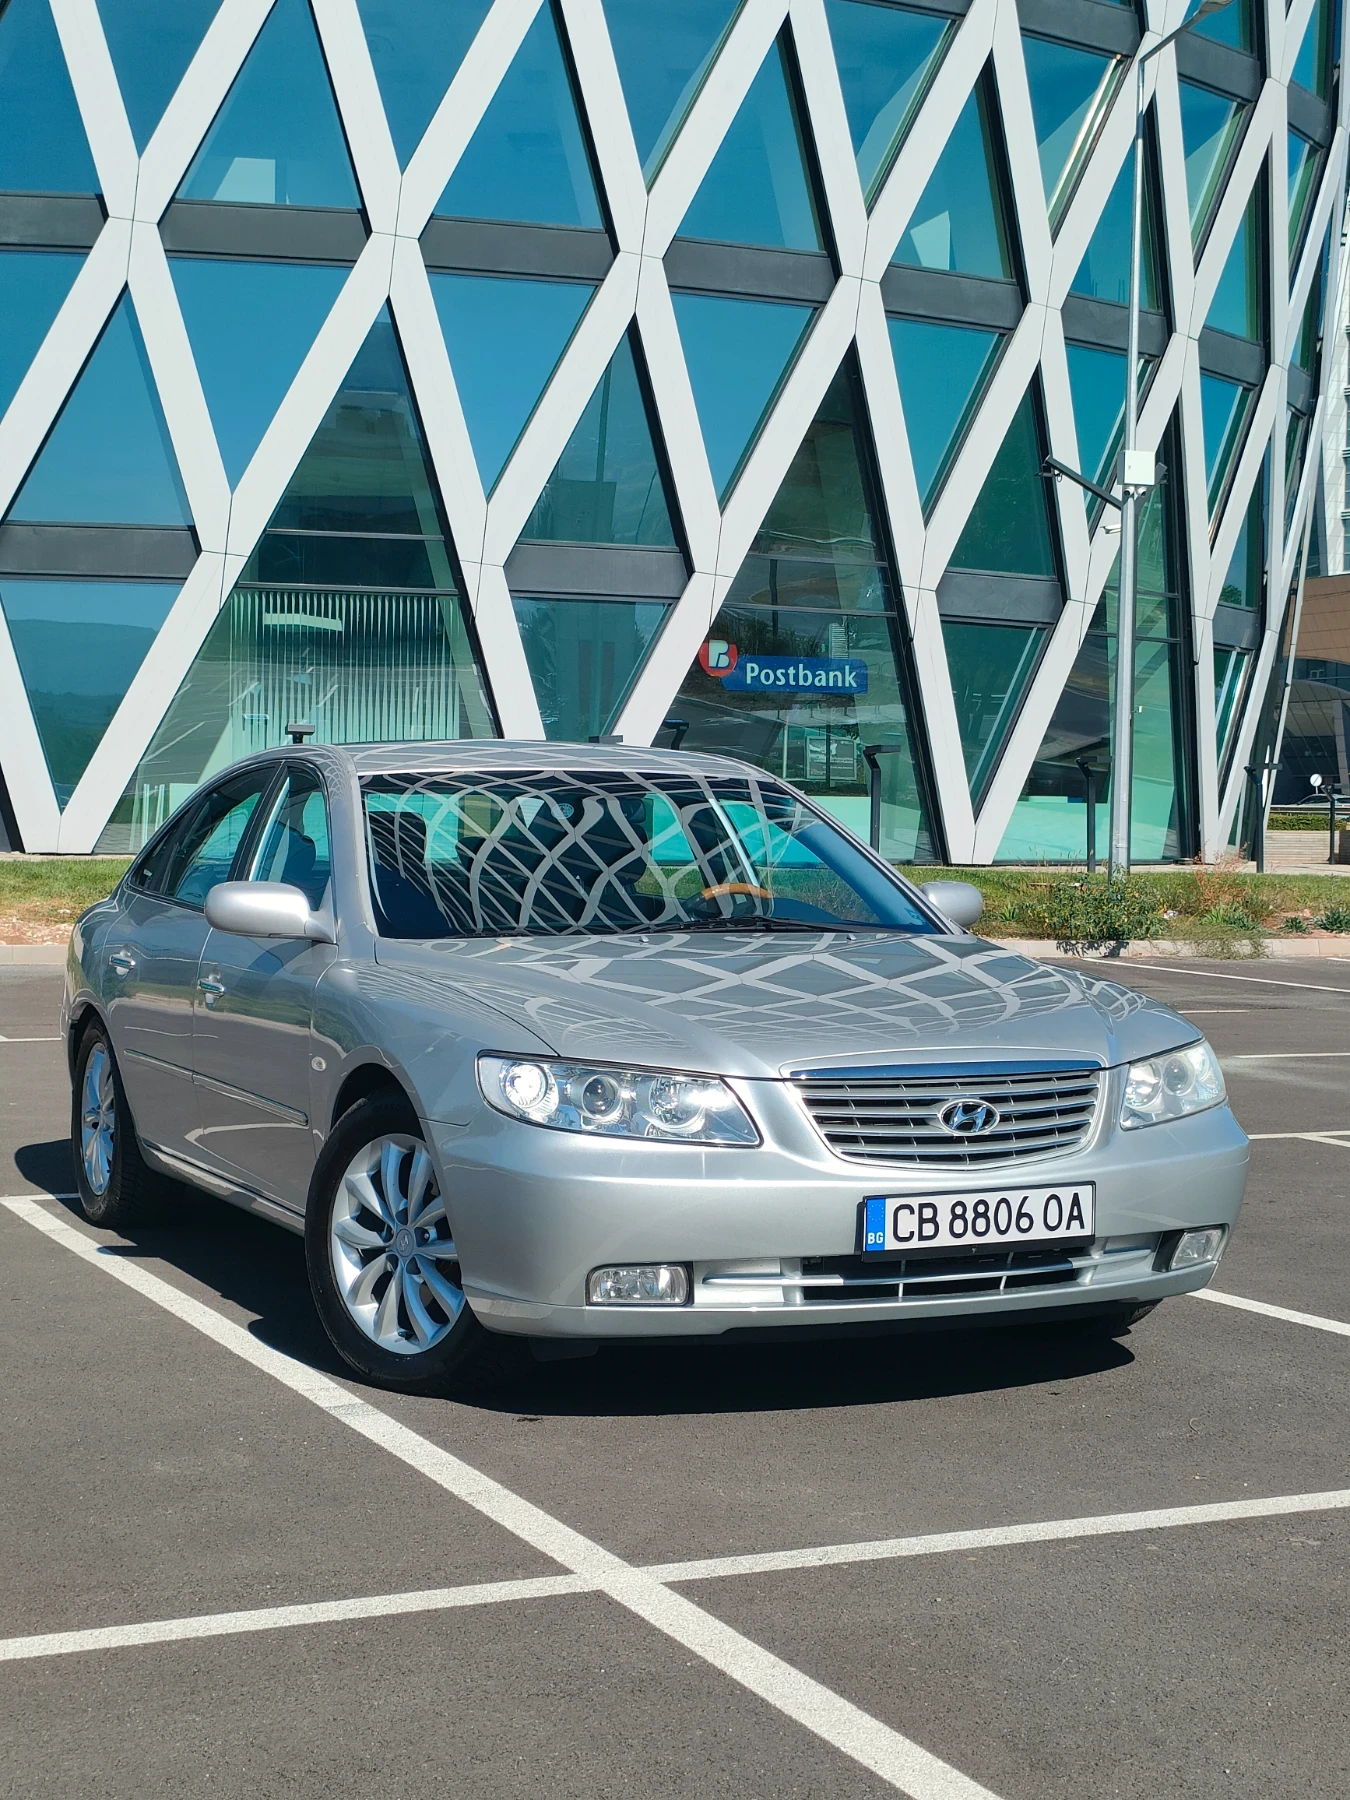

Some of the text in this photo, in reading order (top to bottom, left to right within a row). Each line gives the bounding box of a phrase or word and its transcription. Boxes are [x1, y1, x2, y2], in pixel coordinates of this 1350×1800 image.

[746, 663, 857, 687] Postbank
[892, 1202, 940, 1243] CB
[948, 1196, 1034, 1239] 8806
[867, 1232, 884, 1244] BG
